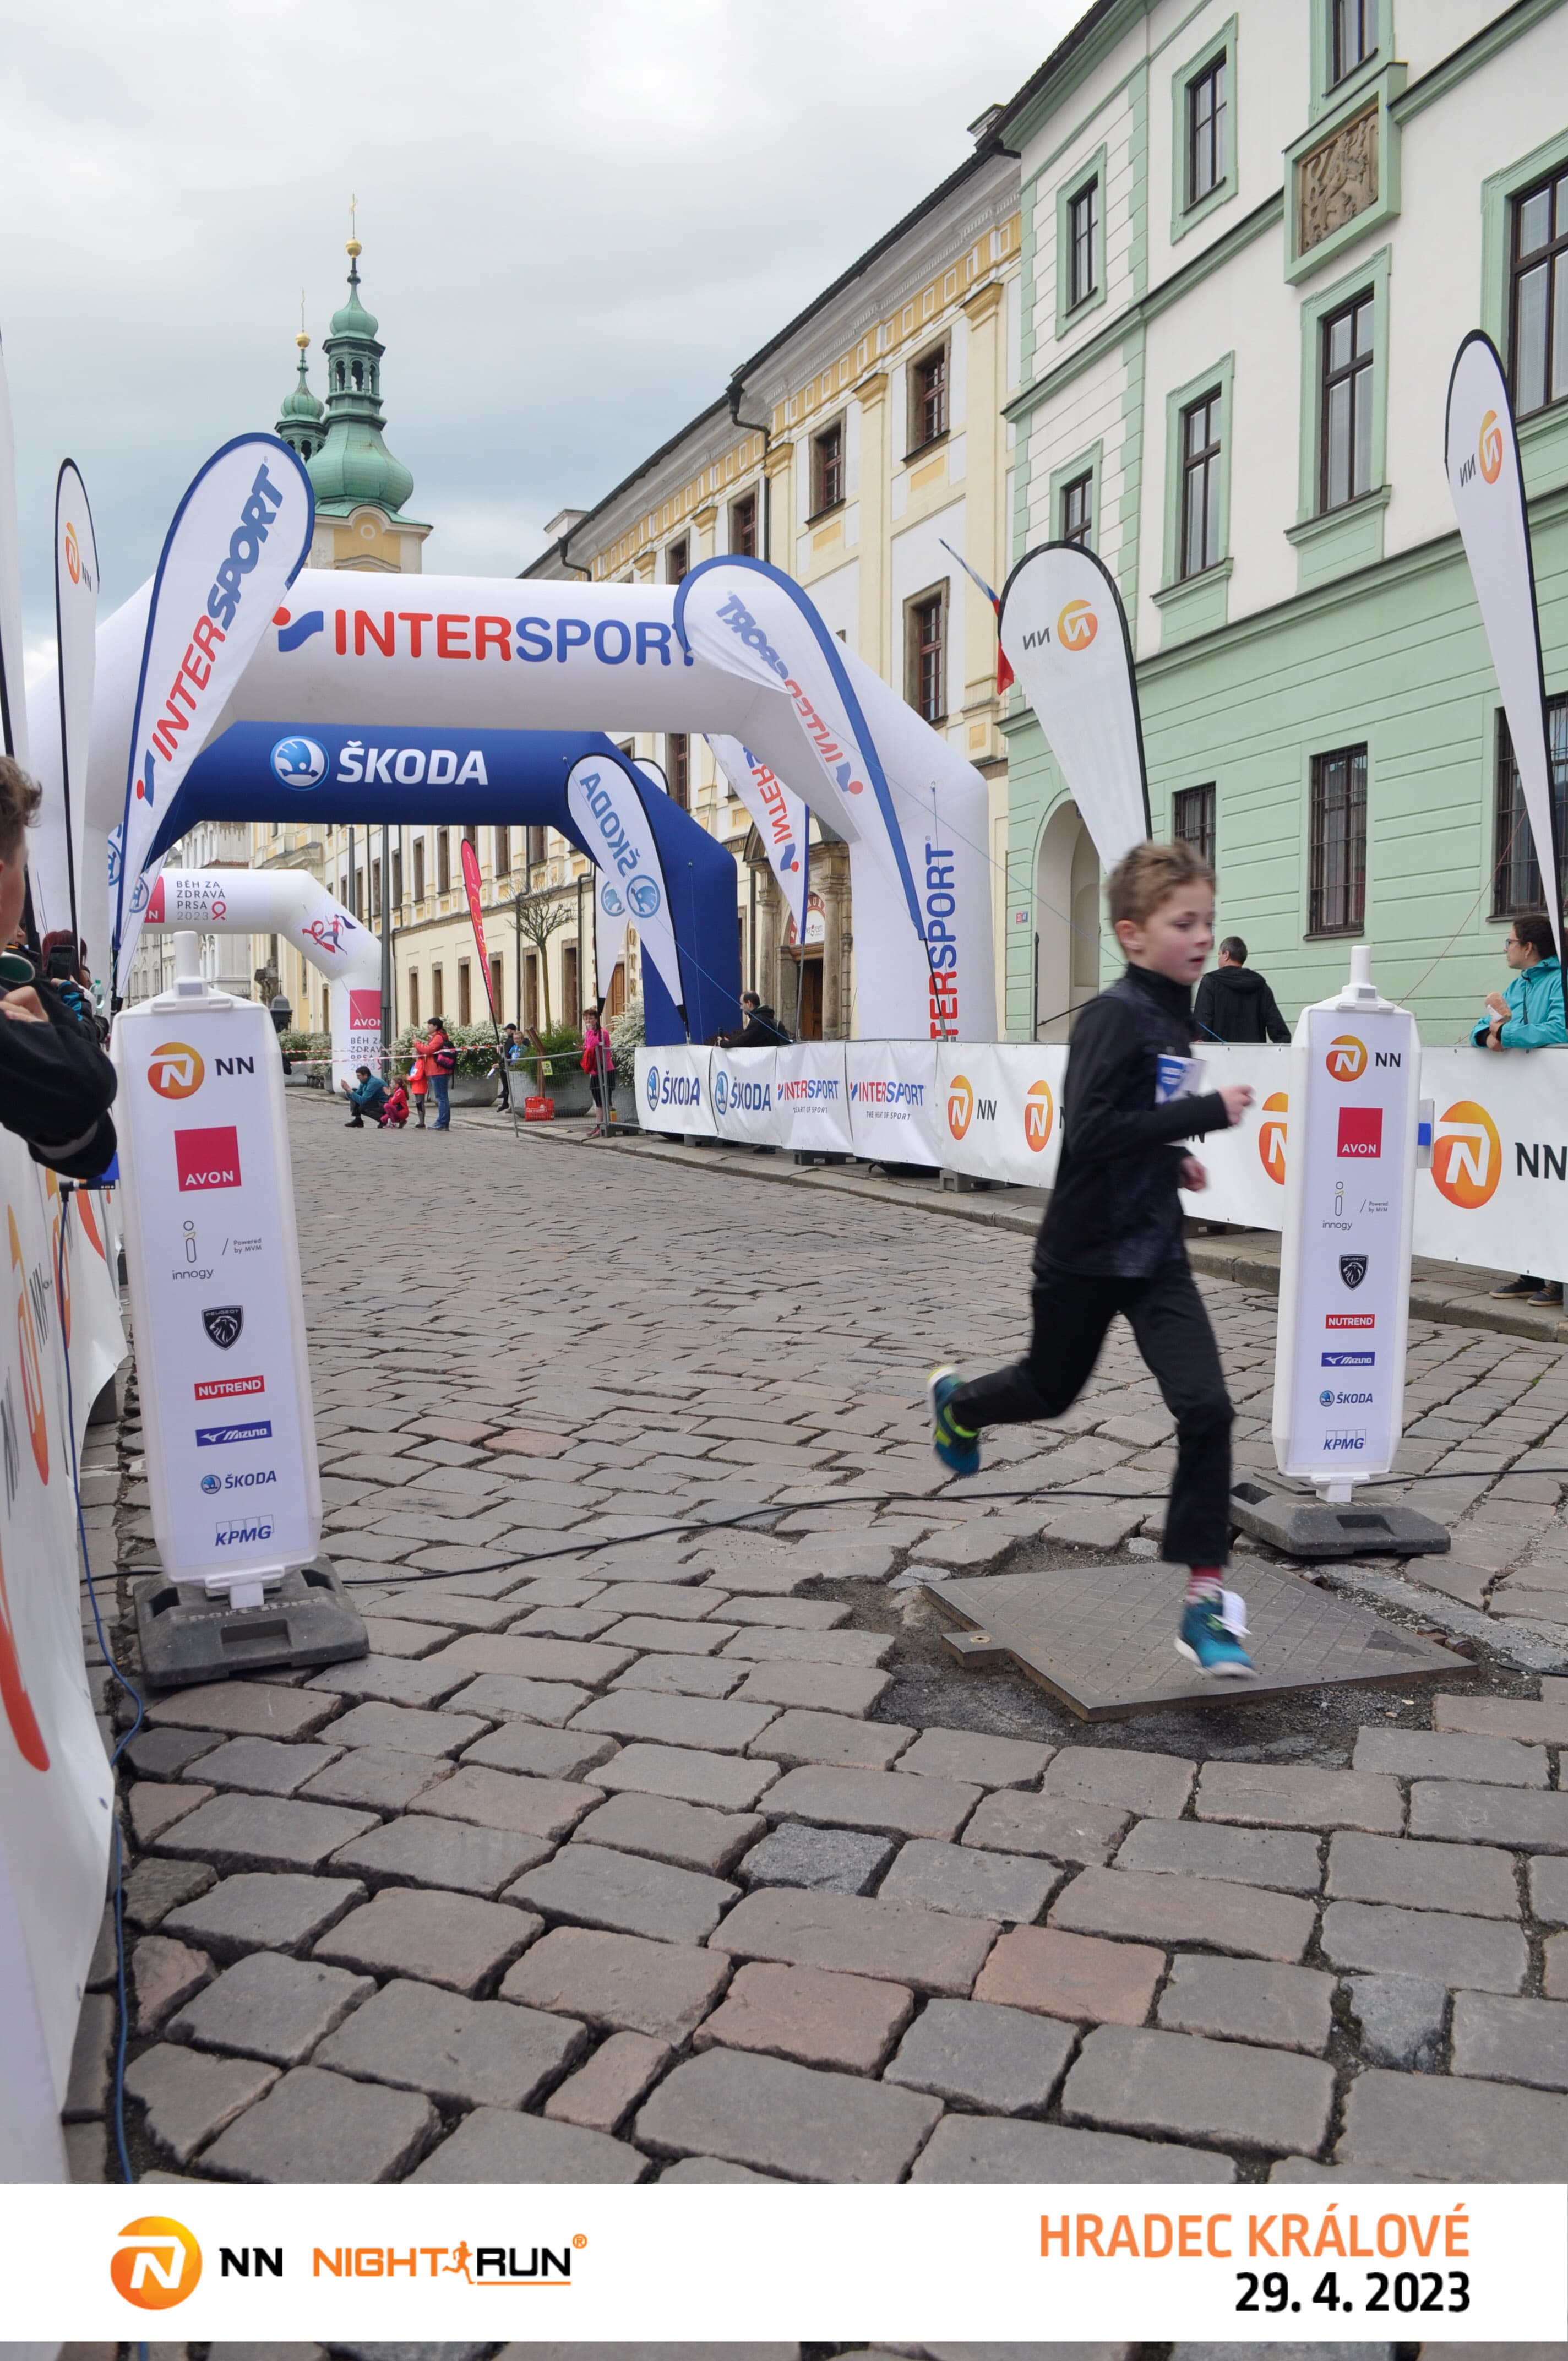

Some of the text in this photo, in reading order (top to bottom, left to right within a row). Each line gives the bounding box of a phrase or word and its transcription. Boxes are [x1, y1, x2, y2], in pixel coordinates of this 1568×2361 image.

[152, 463, 284, 762] INTERSPORT
[337, 740, 489, 786] ŠKODA
[177, 889, 225, 898] ZDRAVÁ
[177, 911, 209, 920] 2023
[215, 1056, 254, 1076] NN
[1375, 1052, 1401, 1067] NN
[661, 1071, 700, 1106] ŠKODA
[729, 1077, 771, 1111] ŠKODA
[784, 1080, 839, 1100] INTERSPORT
[859, 1082, 924, 1106] INTERSPORT
[890, 1112, 911, 1120] SPORT
[977, 1099, 997, 1121] NN
[1341, 1144, 1376, 1154] AVON
[1515, 1142, 1567, 1181] NN
[185, 1170, 234, 1185] AVON
[1322, 1220, 1352, 1231] innogy
[172, 1269, 214, 1280] innogy
[1328, 1317, 1373, 1326] NUTREND
[198, 1379, 262, 1397] NUTREND
[1336, 1392, 1373, 1404] ŠKODA
[1323, 1437, 1365, 1450] KPMG
[225, 1470, 276, 1489] ŠKODA
[215, 1525, 272, 1546] KPMG
